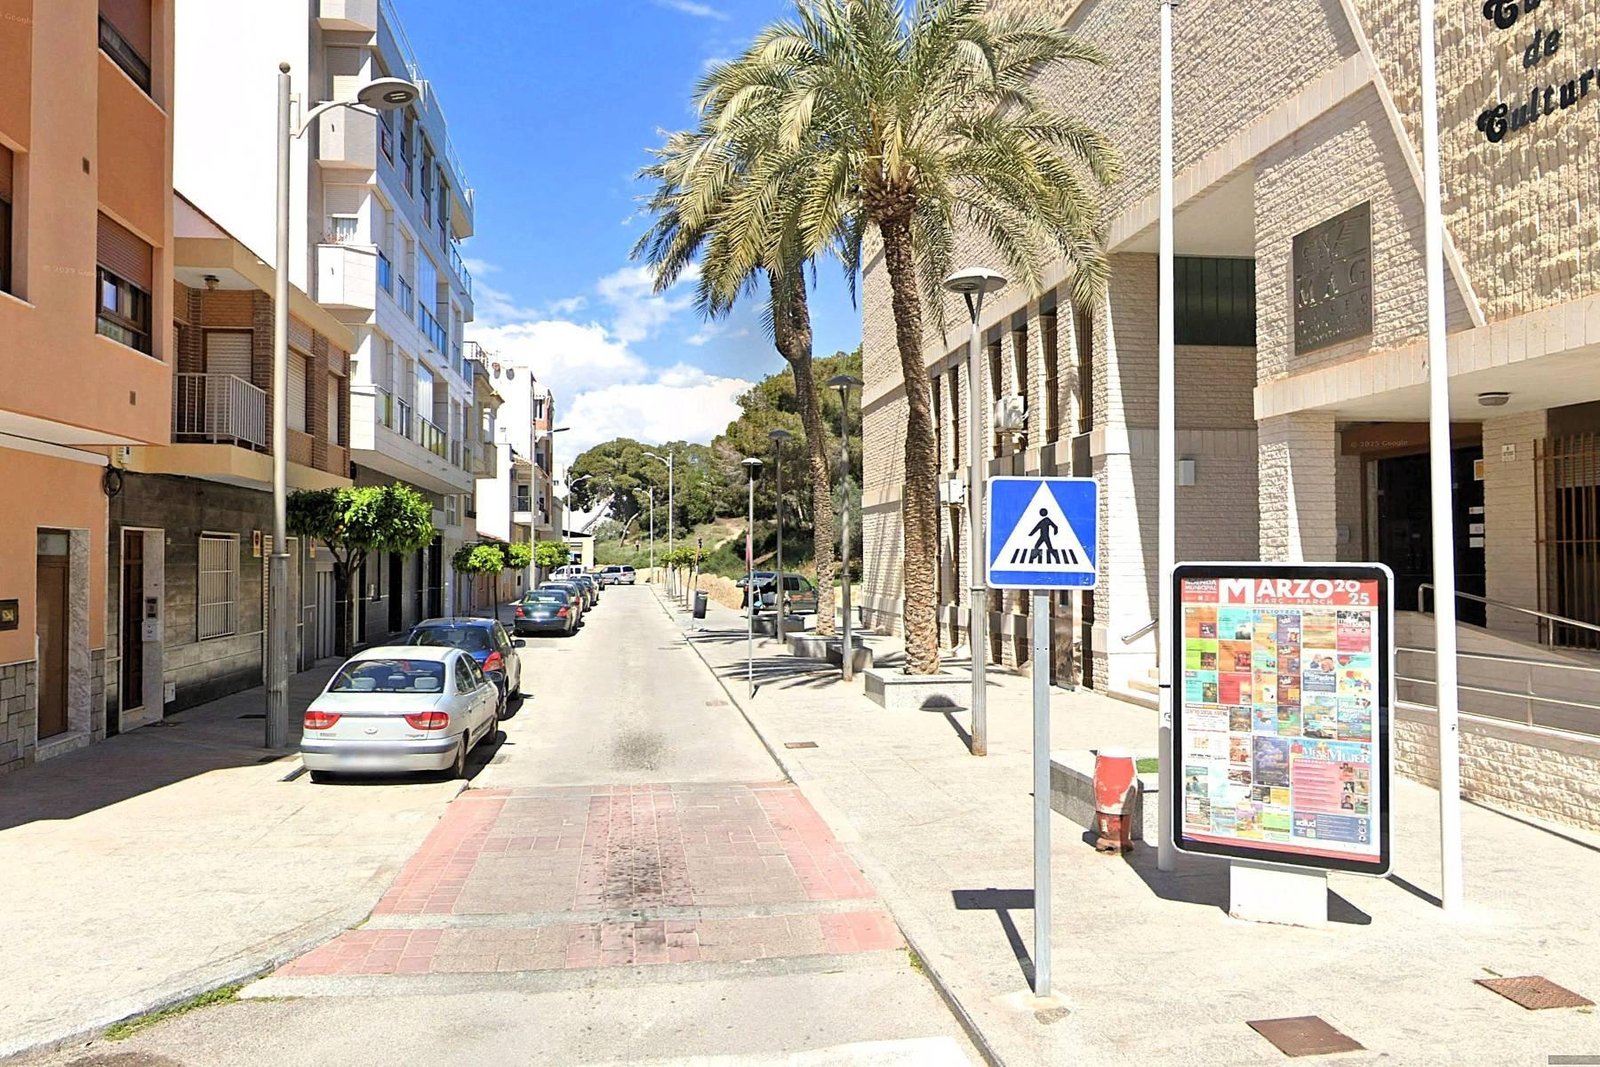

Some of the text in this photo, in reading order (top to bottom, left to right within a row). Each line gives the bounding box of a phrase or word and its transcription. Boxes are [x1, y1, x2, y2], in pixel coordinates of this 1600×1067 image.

[1523, 28, 1563, 69] de
[1476, 68, 1600, 143] Cultur
[1219, 579, 1333, 604] MARZO
